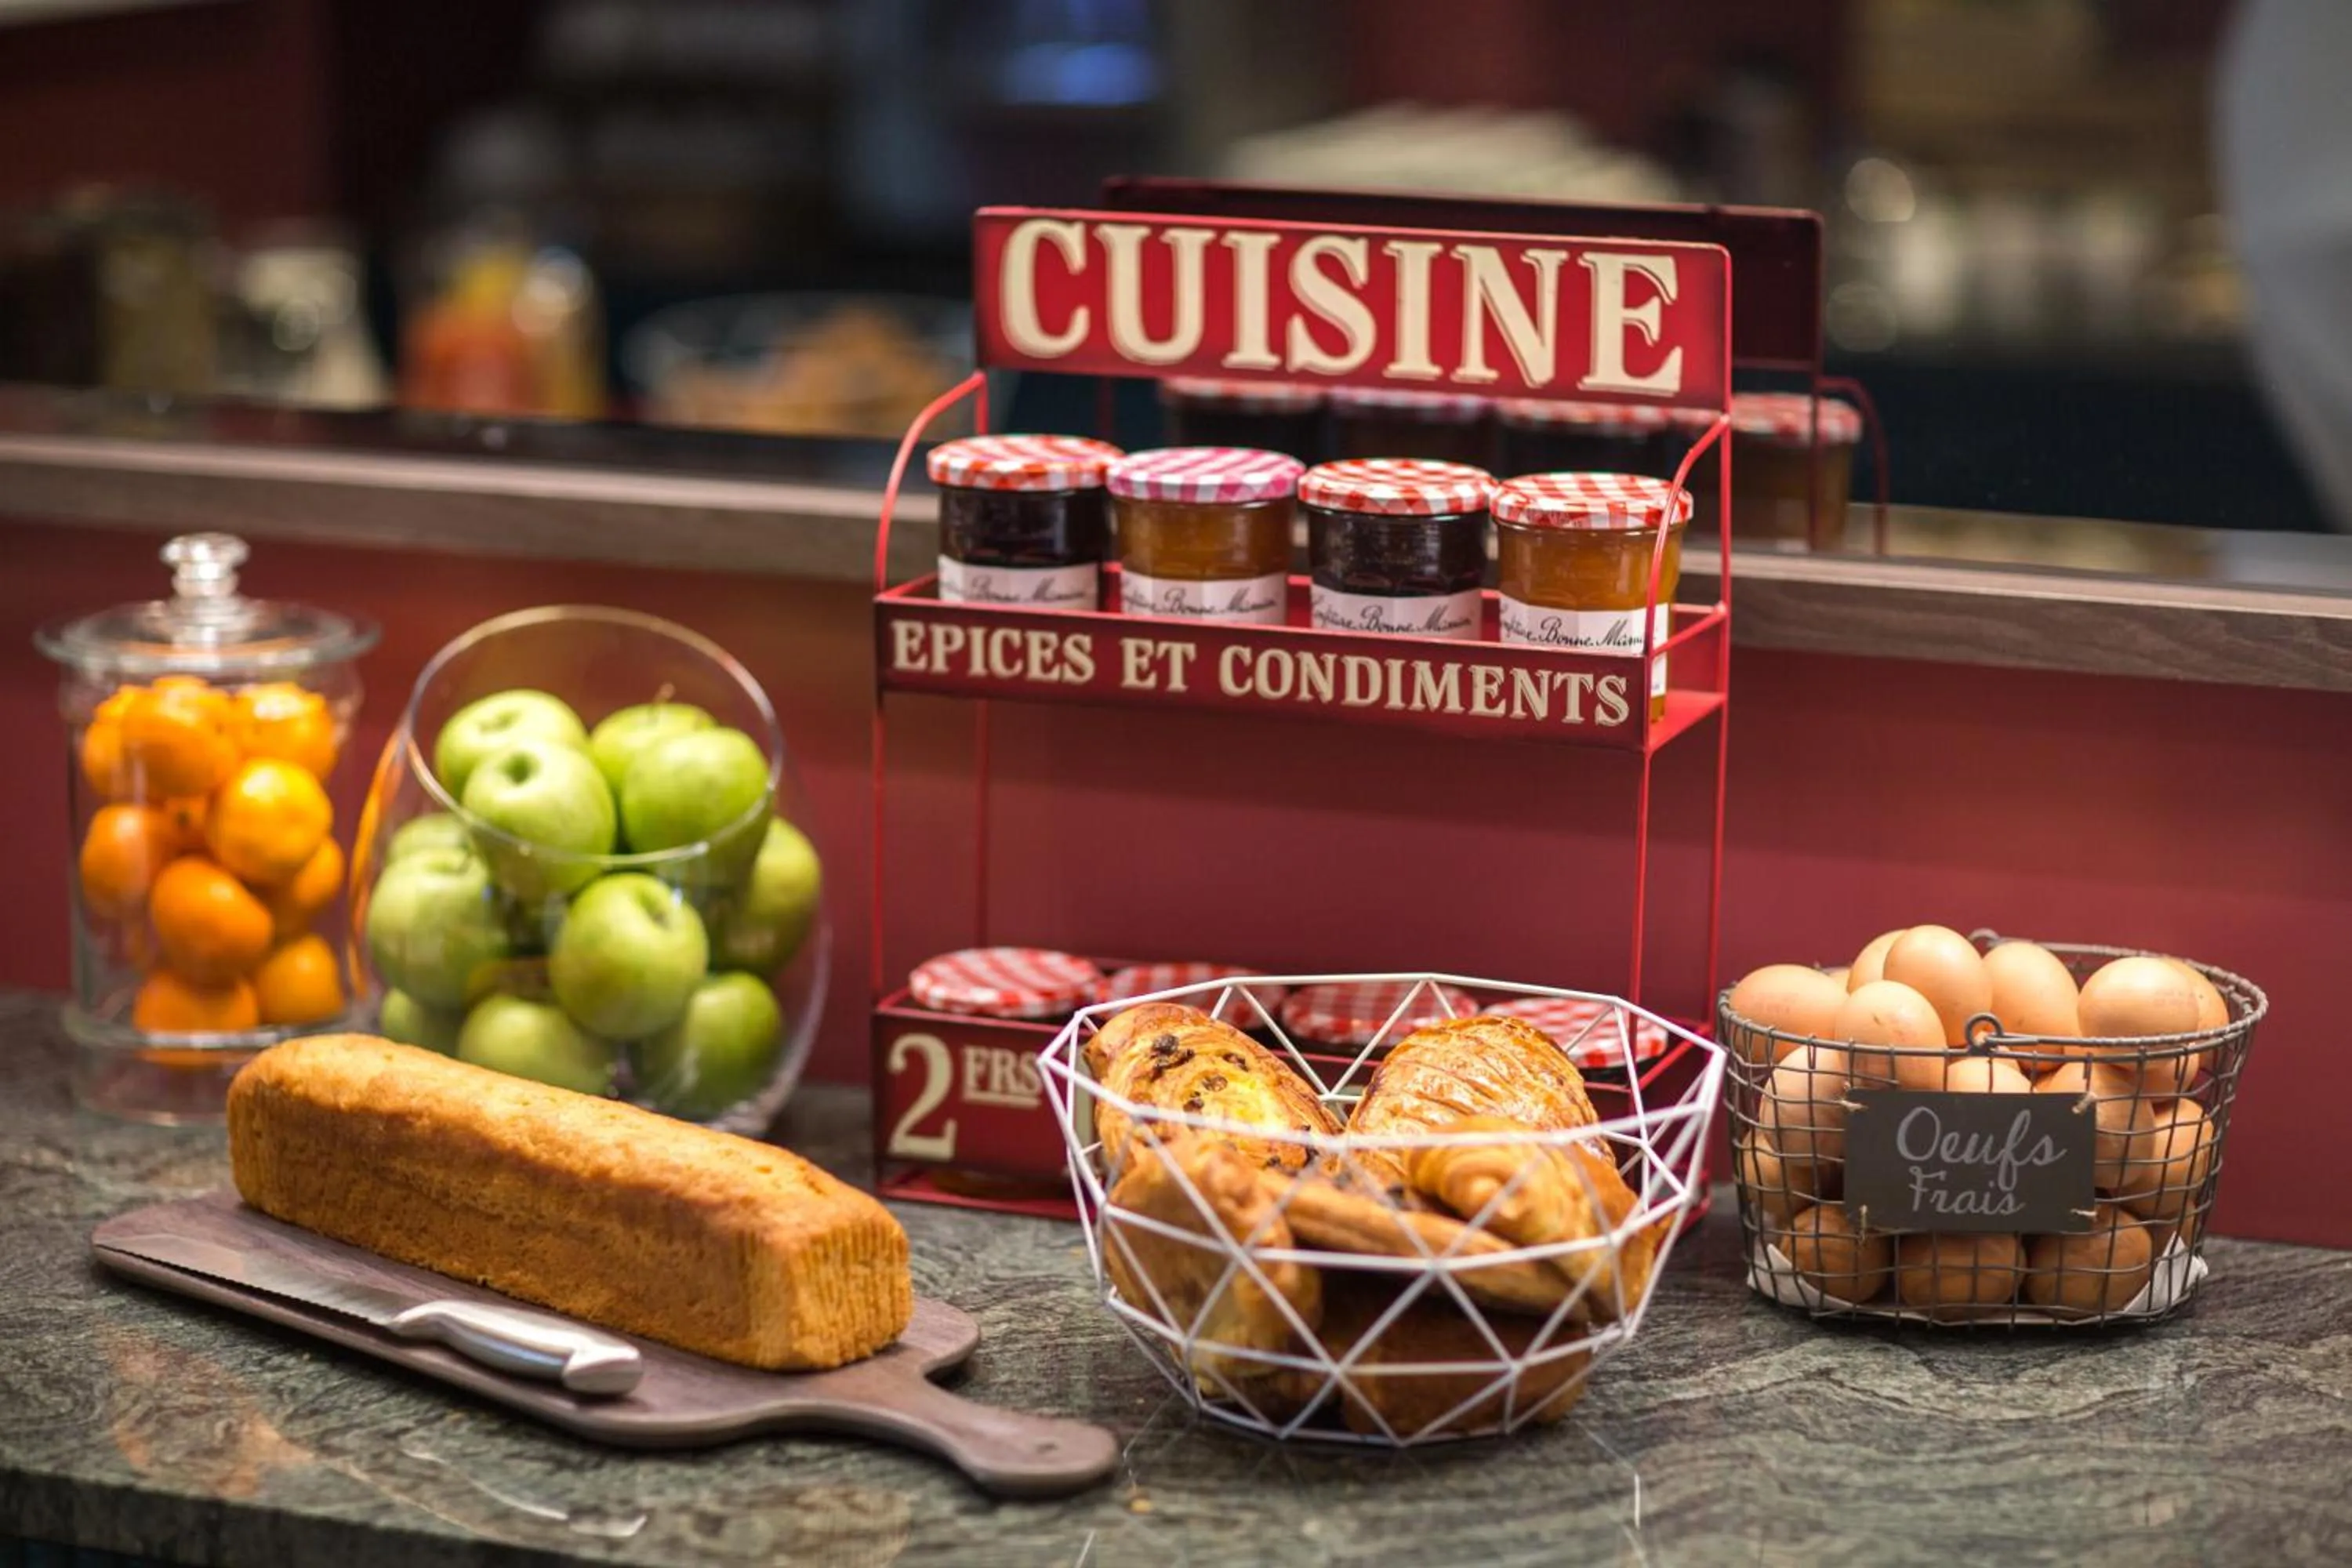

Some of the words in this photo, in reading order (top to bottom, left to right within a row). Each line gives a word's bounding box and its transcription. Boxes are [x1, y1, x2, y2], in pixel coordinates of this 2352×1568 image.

[999, 218, 1682, 396] CUISINE
[1359, 604, 1416, 633] Bonne
[1539, 615, 1595, 646] Bonne
[891, 620, 1095, 684] EPICES
[1120, 637, 1196, 691] ET
[1218, 644, 1628, 728] CONDIMENTS
[887, 1033, 957, 1160] 2
[962, 1044, 1044, 1096] FRS
[1896, 1106, 2068, 1192] Oeufs
[1908, 1166, 2026, 1216] Frais
